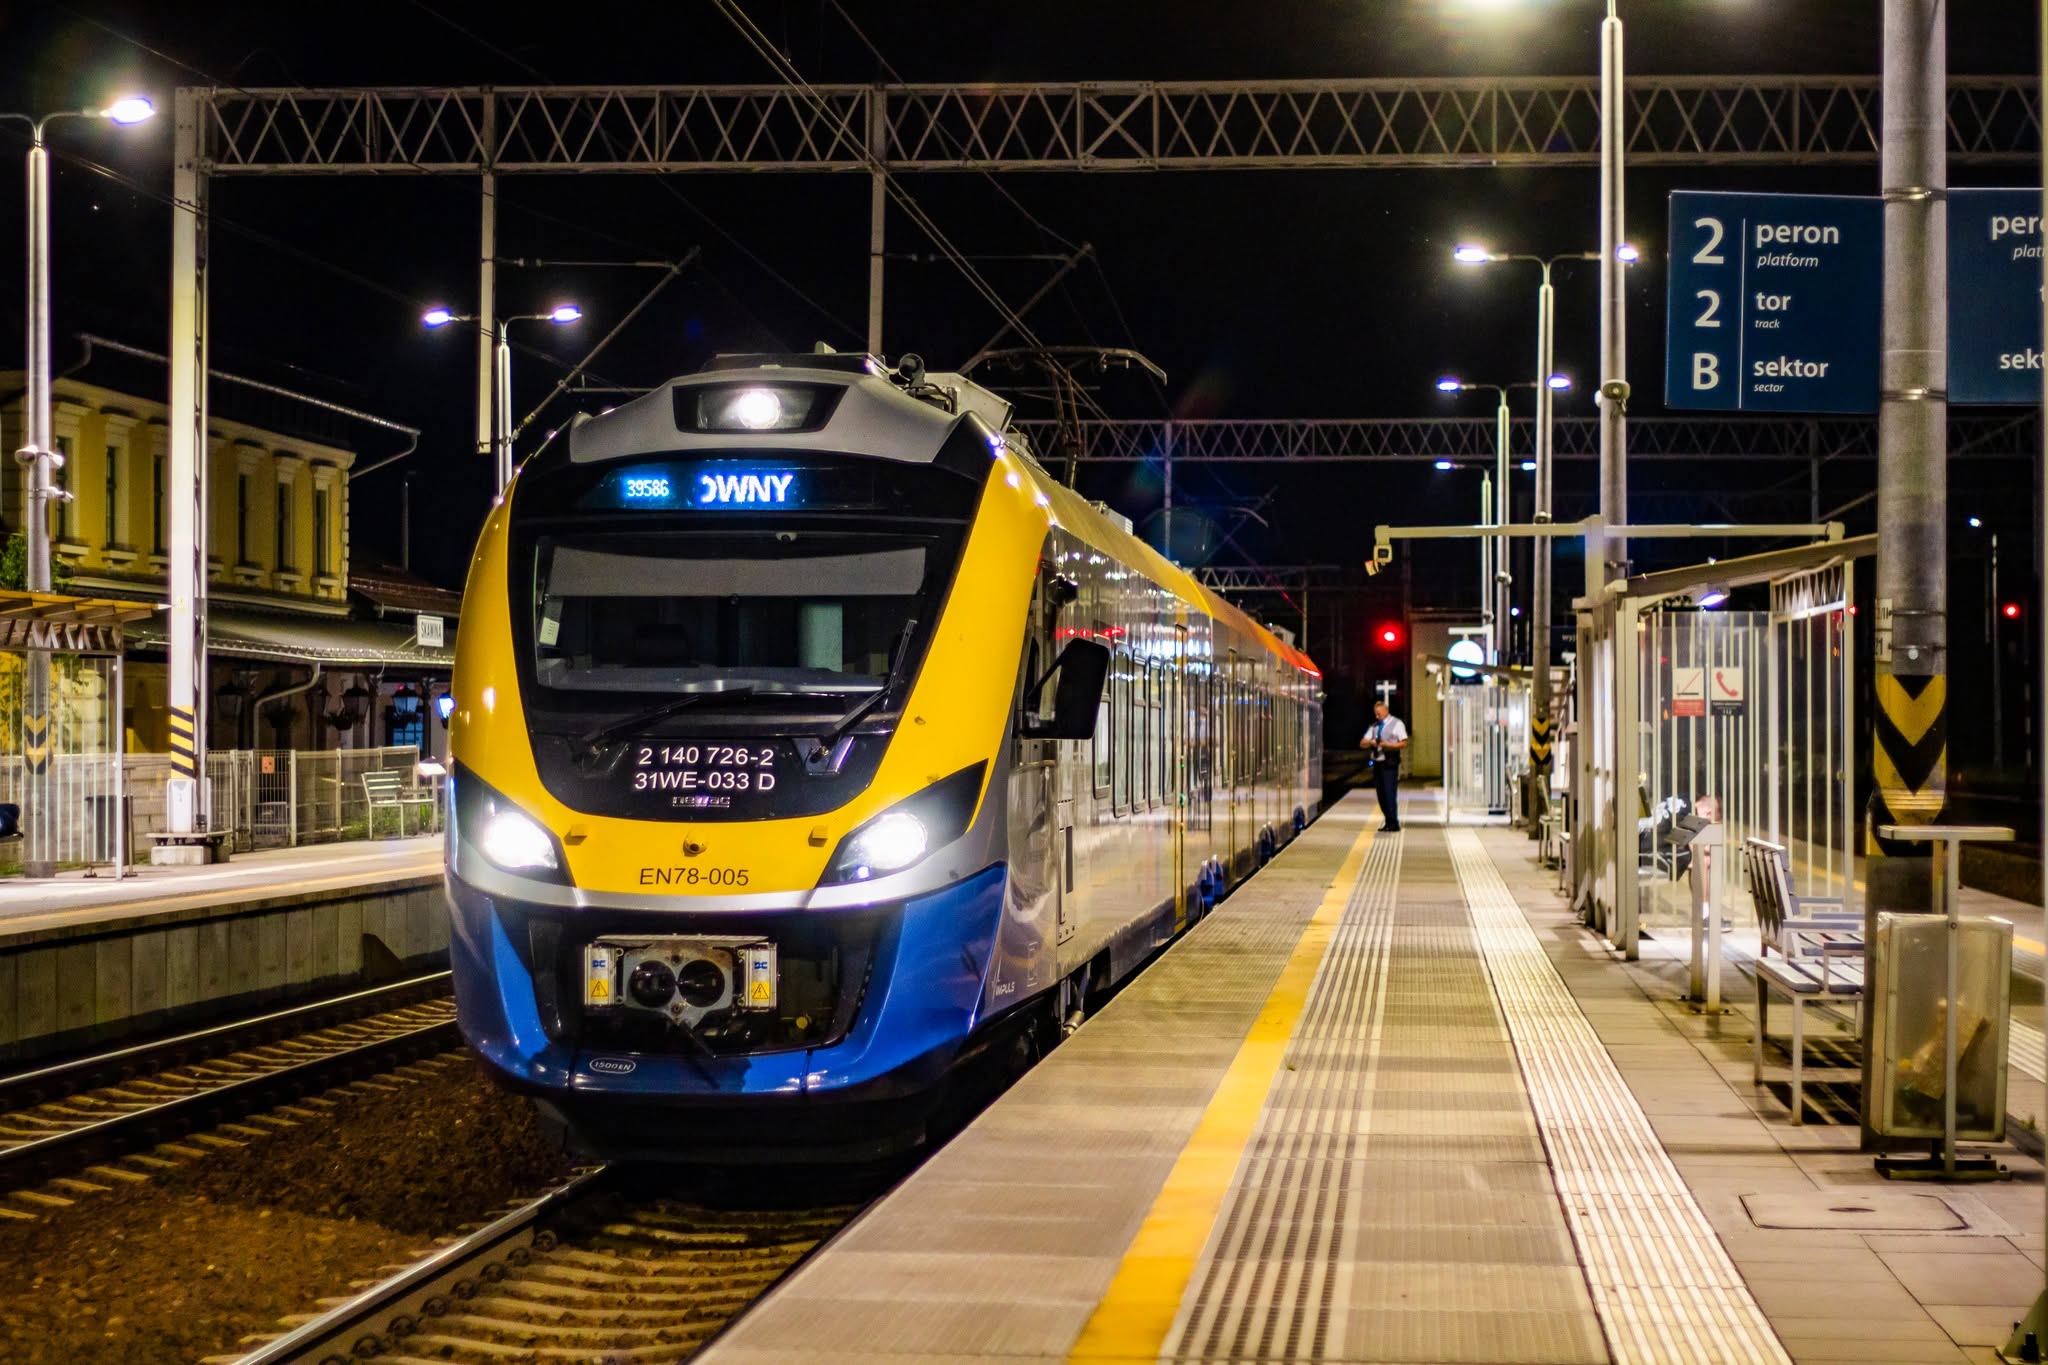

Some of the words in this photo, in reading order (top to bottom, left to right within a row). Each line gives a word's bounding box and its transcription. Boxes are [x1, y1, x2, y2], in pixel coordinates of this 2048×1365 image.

[1992, 215, 2044, 241] per
[1692, 217, 1725, 265] 2
[1755, 221, 1840, 249] peron
[1756, 252, 1819, 268] platform
[1694, 289, 1721, 328] 2
[1756, 291, 1791, 311] tor
[1754, 318, 1781, 329] track
[1692, 352, 1720, 391] B
[1753, 355, 1830, 378] sektor
[1753, 382, 1784, 393] sector
[627, 479, 670, 497] 39586
[639, 747, 653, 765] 2
[661, 746, 700, 764] 140
[706, 747, 774, 766] 726-2
[634, 771, 750, 790] 31WE-033
[758, 773, 776, 791] D
[639, 867, 749, 886] EN78-005
